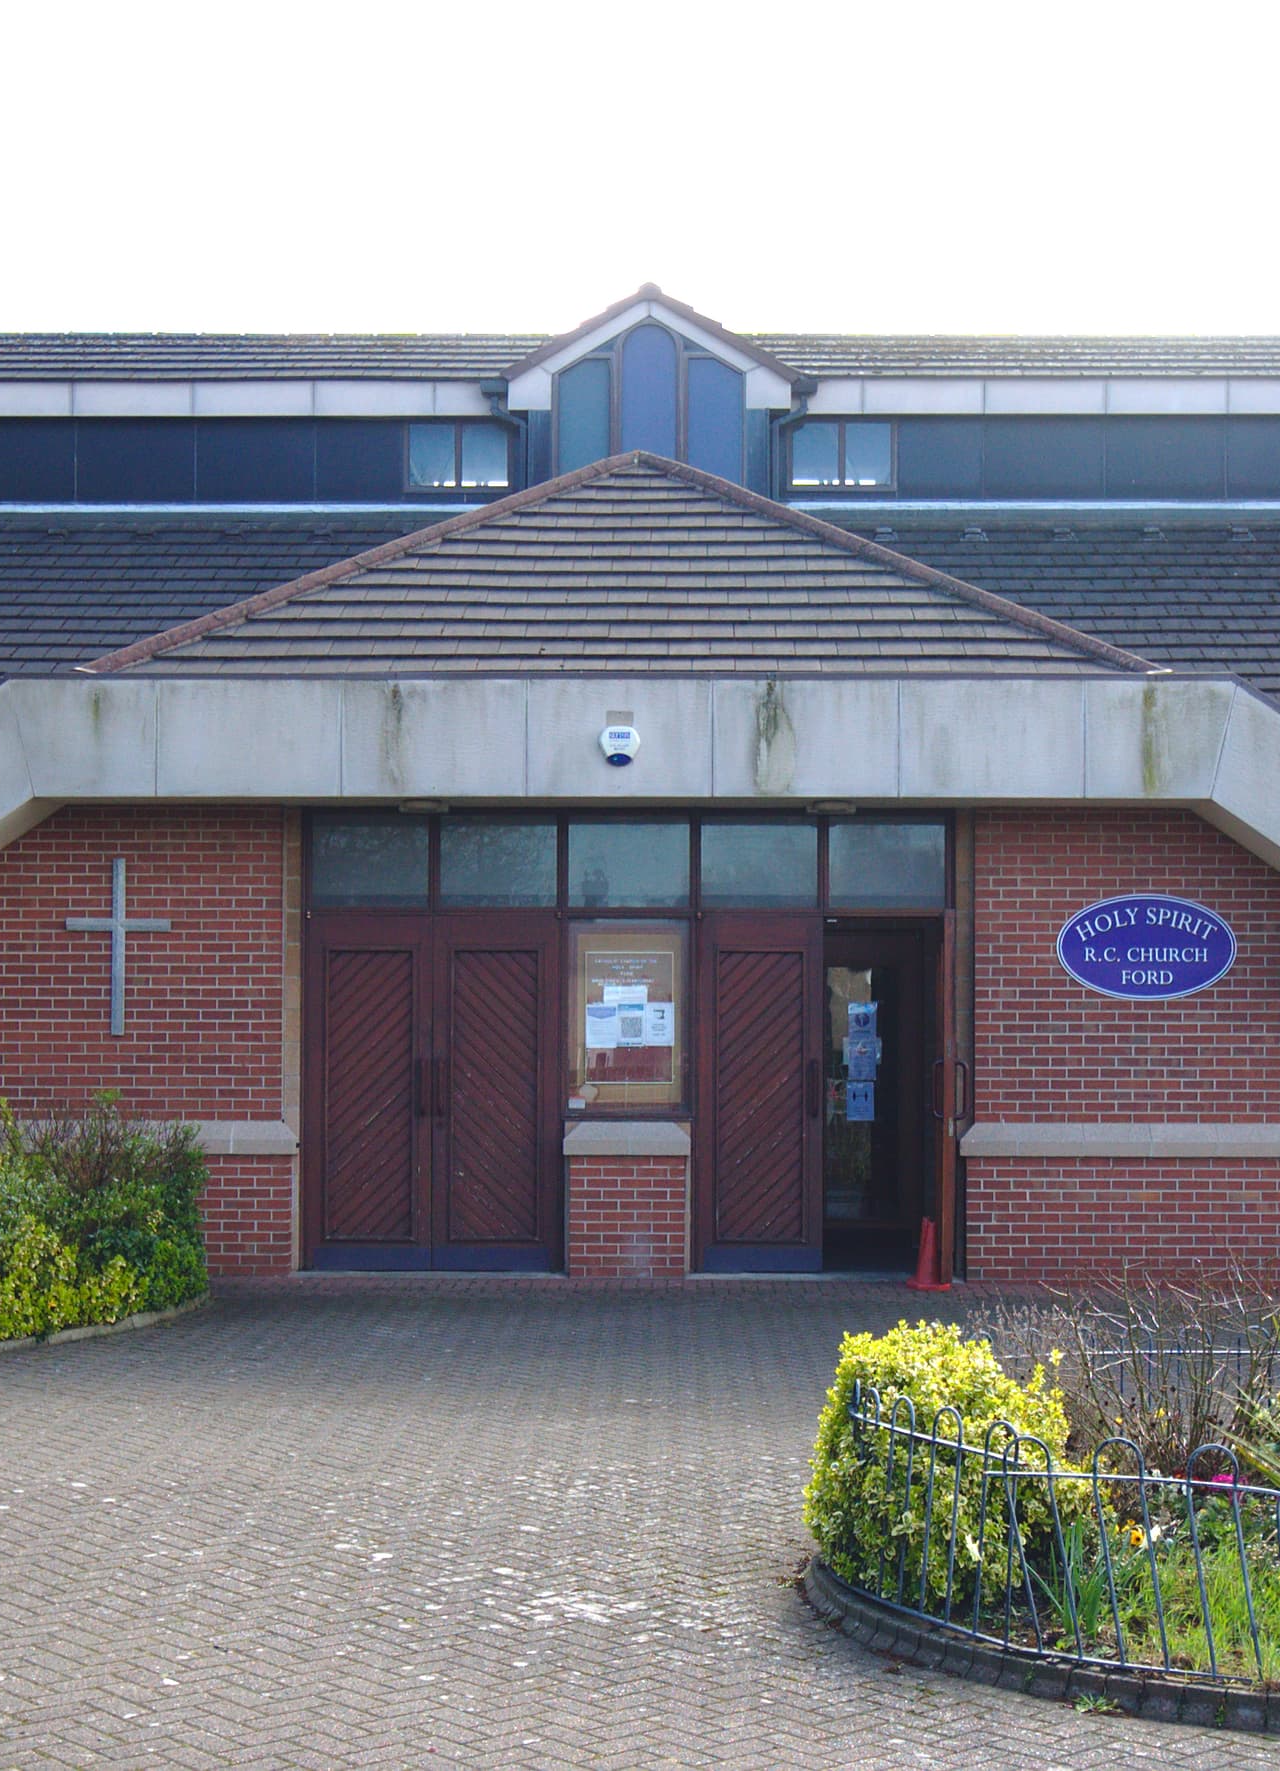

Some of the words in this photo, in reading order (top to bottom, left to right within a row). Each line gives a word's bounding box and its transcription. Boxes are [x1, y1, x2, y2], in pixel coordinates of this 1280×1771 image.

[1075, 907, 1139, 942] HOLY
[1145, 907, 1218, 940] SPIRIT
[1084, 947, 1121, 962] R.C.
[1127, 947, 1208, 963] CHURCH
[1121, 970, 1173, 985] FORD
